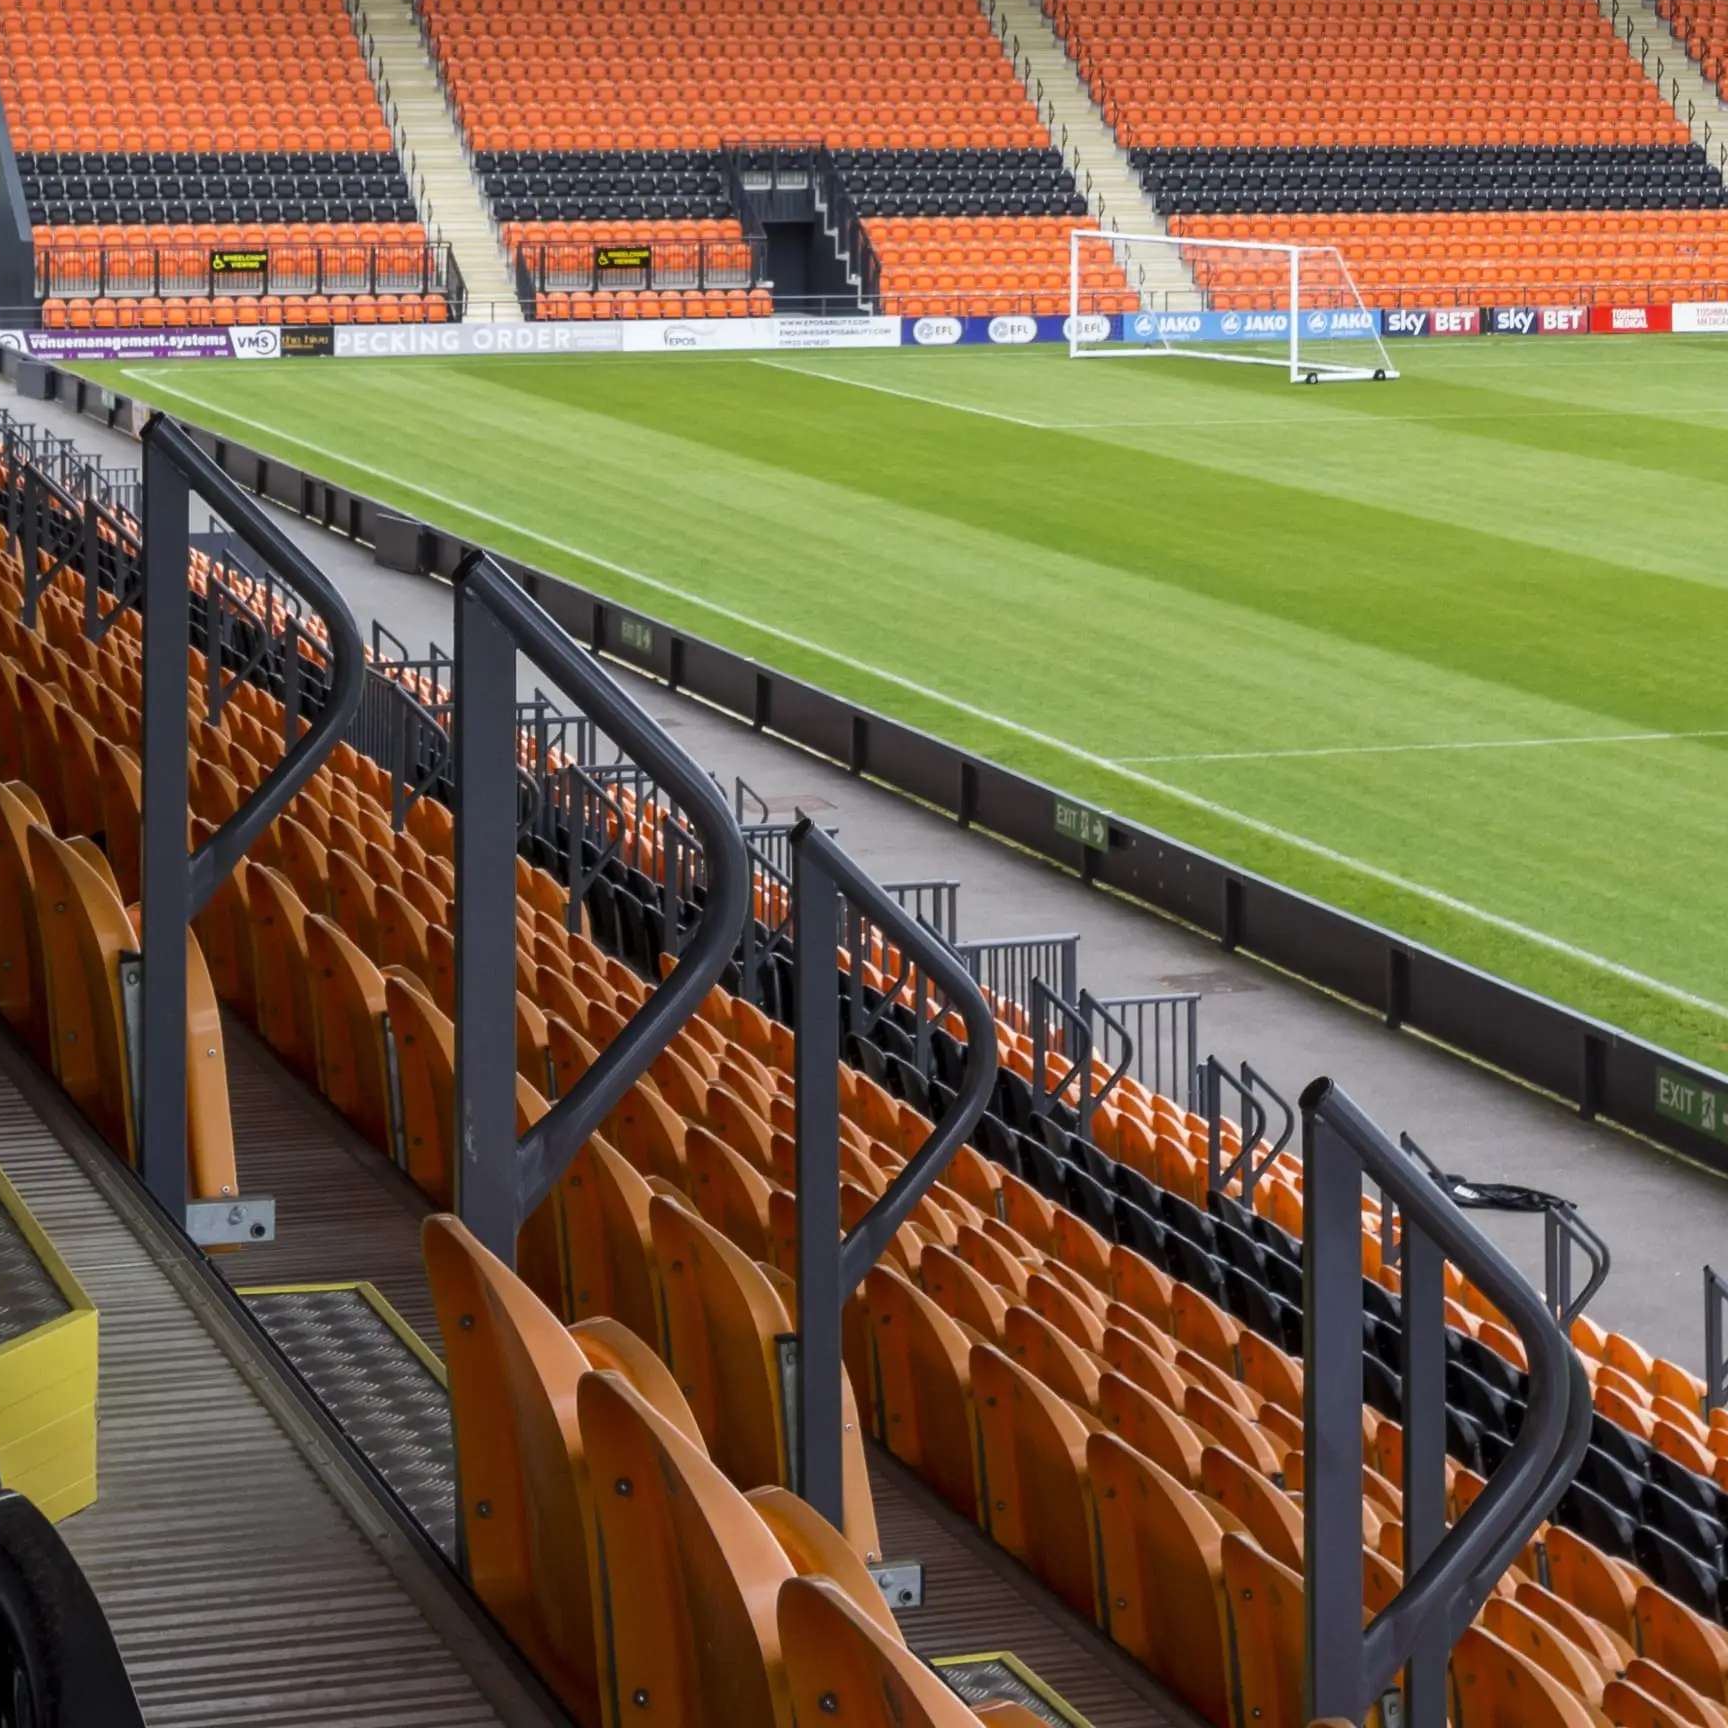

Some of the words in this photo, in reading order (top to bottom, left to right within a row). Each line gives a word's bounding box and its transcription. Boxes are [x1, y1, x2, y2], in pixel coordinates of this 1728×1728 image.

[1612, 308, 1646, 318] TOSHIBA
[1696, 308, 1728, 316] TOSHIBA
[1084, 323, 1103, 333] EFL
[1158, 316, 1201, 332] JAKO
[1243, 316, 1288, 331] JAKO
[1328, 314, 1373, 329] JAKO
[1388, 309, 1427, 335] sky
[1434, 311, 1475, 332] BET
[1497, 308, 1536, 334] sky
[1543, 310, 1583, 330] BET
[1613, 318, 1648, 328] MEDICAL
[935, 326, 953, 336] EFL
[1010, 325, 1029, 335] EFL
[30, 334, 227, 351] venuemanagement.systems
[237, 336, 269, 348] VMS
[336, 326, 459, 353] PECKING
[472, 328, 570, 350] ORDER
[668, 337, 697, 346] EPOS
[1056, 803, 1078, 830] EXIT
[1660, 1077, 1695, 1114] EXIT
